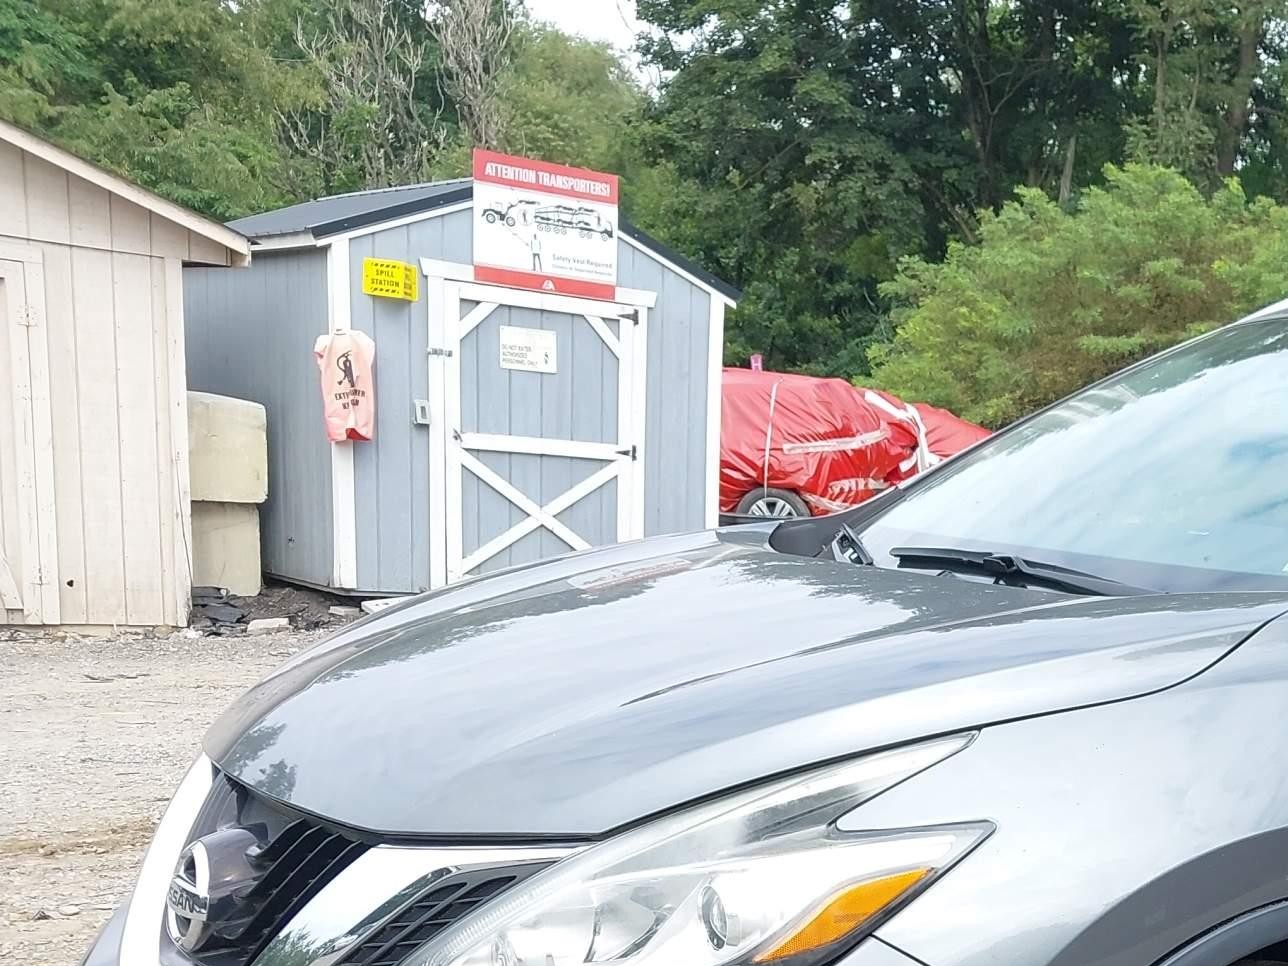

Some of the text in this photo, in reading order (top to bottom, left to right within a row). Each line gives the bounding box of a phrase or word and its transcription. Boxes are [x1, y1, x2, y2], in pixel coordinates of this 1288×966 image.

[485, 162, 611, 197] ATTENTION TRANSPORTERS!
[375, 268, 394, 278] SPILL
[370, 278, 400, 288] STATION
